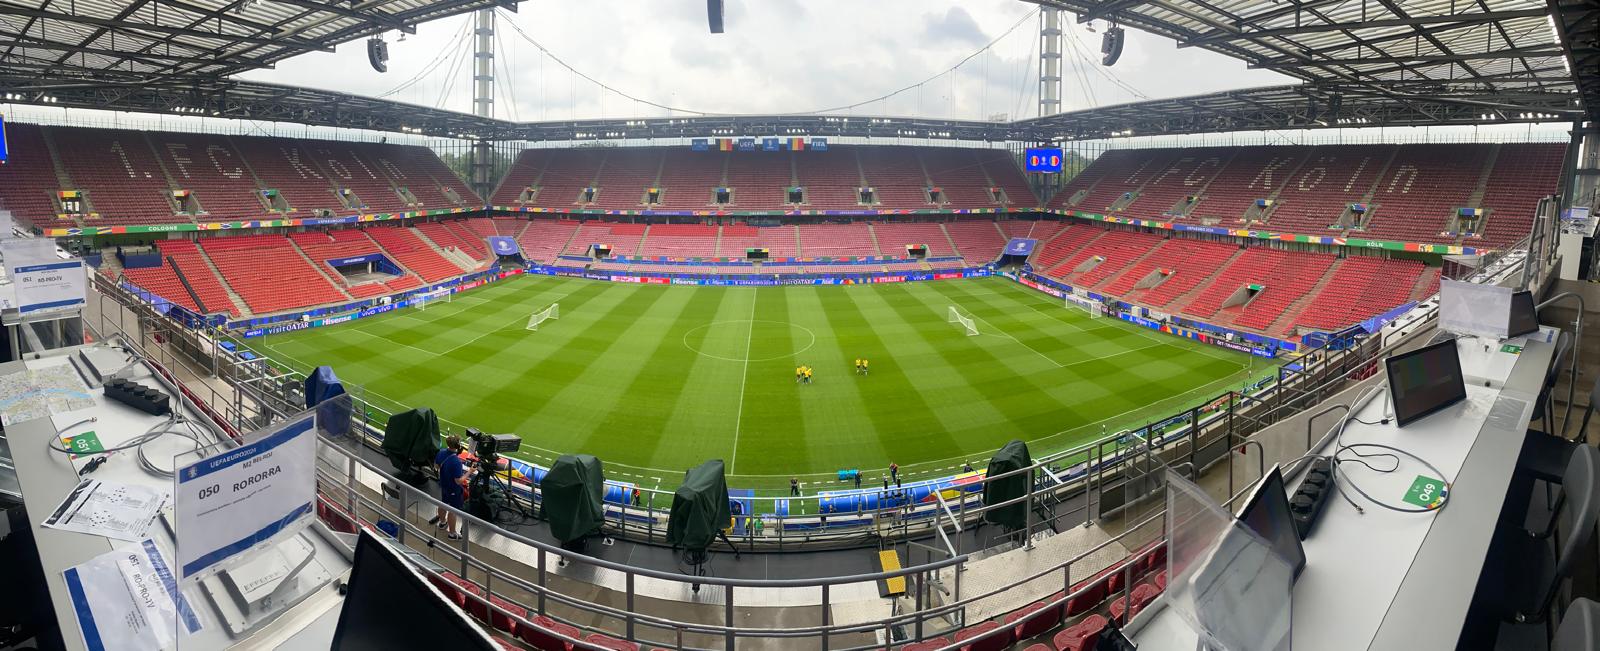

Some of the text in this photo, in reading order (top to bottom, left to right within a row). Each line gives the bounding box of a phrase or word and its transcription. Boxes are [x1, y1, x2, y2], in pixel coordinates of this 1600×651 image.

[672, 278, 699, 286] Hisense
[321, 315, 353, 327] Hisense
[76, 438, 91, 452] 051
[198, 483, 221, 500] 050
[1419, 483, 1436, 502] 049
